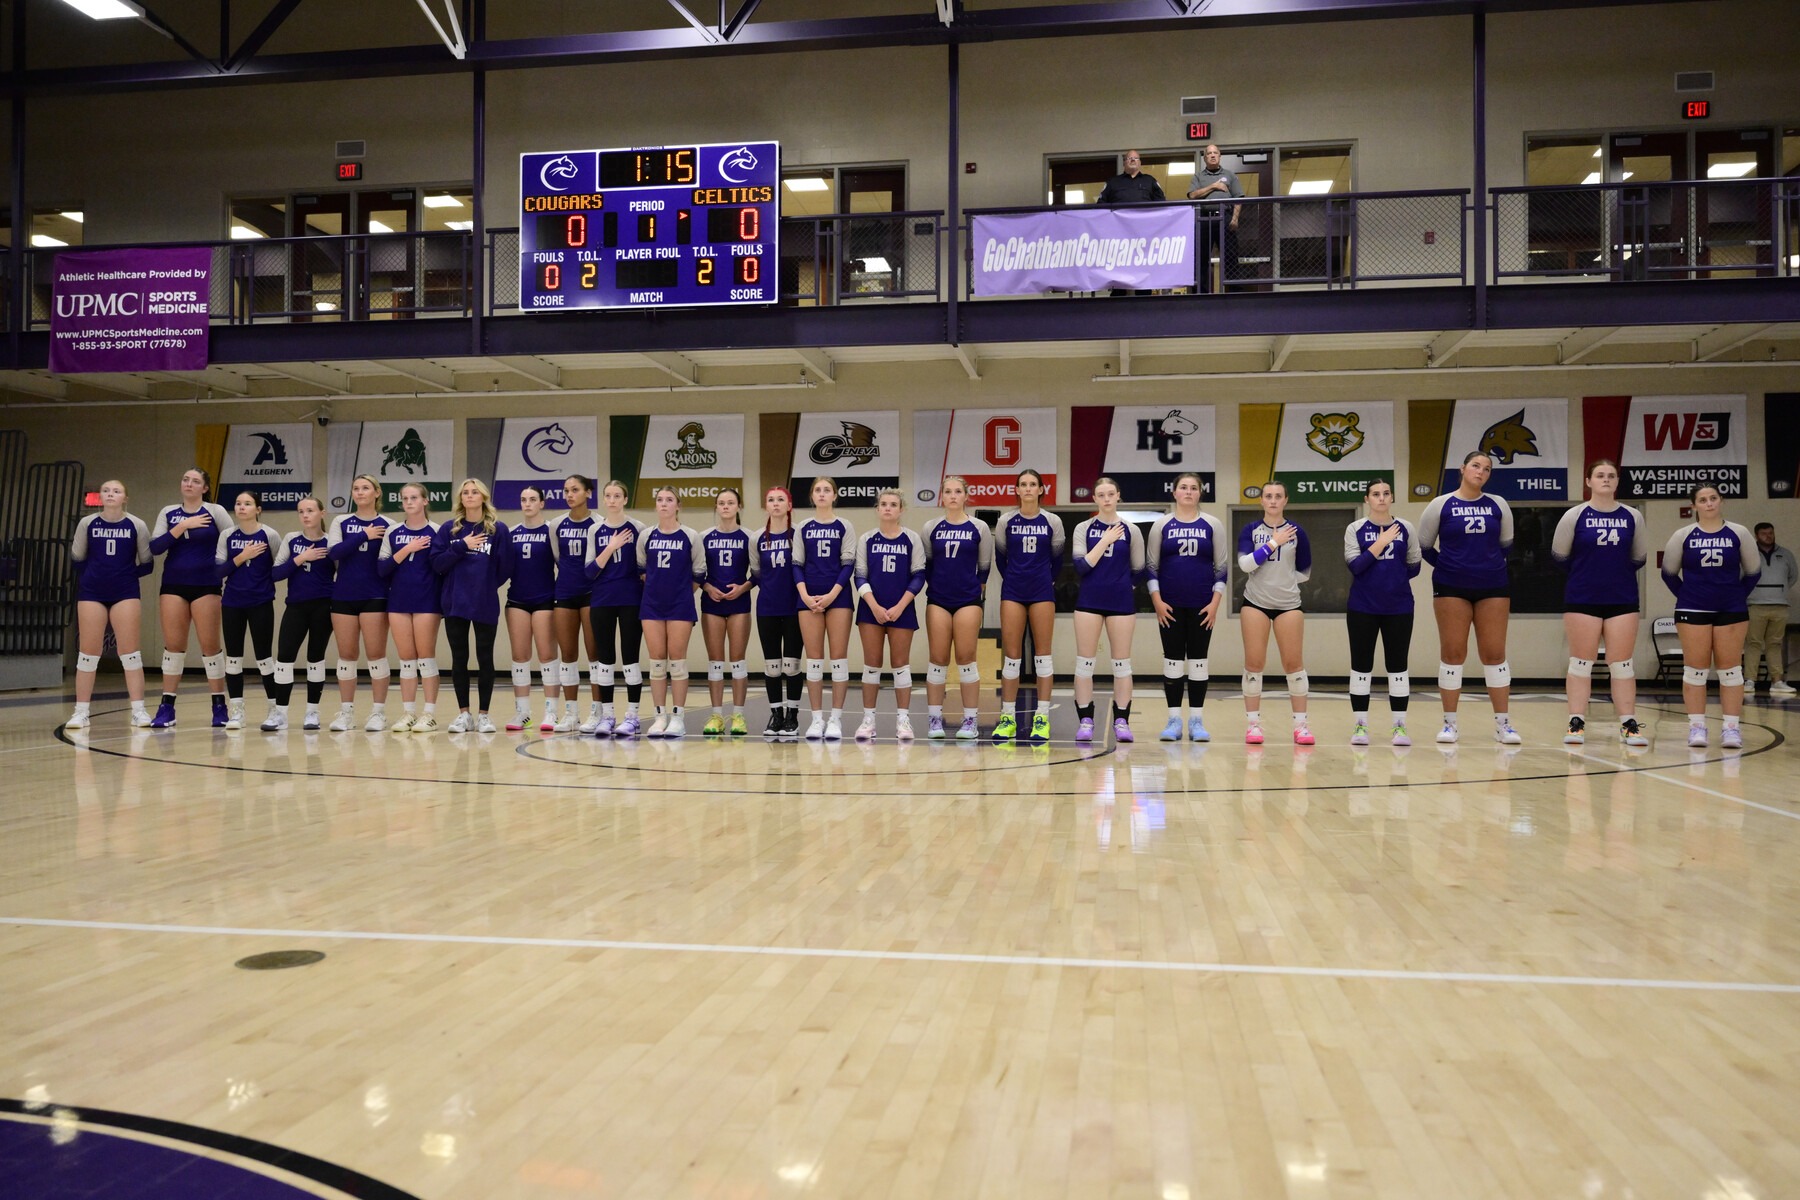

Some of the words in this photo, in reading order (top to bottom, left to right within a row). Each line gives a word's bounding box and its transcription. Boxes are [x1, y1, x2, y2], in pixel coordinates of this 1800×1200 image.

[1687, 102, 1707, 116] EXIT
[1190, 123, 1208, 138] EXIT
[339, 164, 357, 178] EXIT
[636, 151, 693, 182] 1:15
[694, 186, 772, 204] CELTICS
[525, 194, 602, 212] COUGARS
[629, 200, 665, 212] PERIOD
[568, 215, 585, 246] 0
[649, 217, 654, 238] 1
[740, 208, 759, 240] 0
[577, 251, 602, 262] T.O.L.
[616, 248, 652, 260] PLAYER
[656, 247, 681, 258] FOUL
[693, 246, 718, 257] T.O.L.
[731, 244, 763, 256] FOULS
[982, 232, 1186, 272] GoChathamCougars.com
[534, 252, 564, 263] FOULS
[59, 272, 95, 282] Athletic
[97, 271, 146, 280] Healthcare
[150, 270, 192, 279] Provided
[194, 269, 206, 278] by
[582, 264, 596, 288] 2
[698, 259, 712, 284] 2
[744, 258, 758, 283] 0
[545, 265, 559, 290] 0
[149, 292, 197, 302] SPORTS
[533, 295, 564, 306] SCORE
[630, 292, 663, 303] MATCH
[730, 289, 763, 300] SCORE
[56, 292, 138, 318] UPMC
[149, 304, 207, 314] MEDICINE
[56, 328, 203, 339] www.UPMCSportsMedicine.com
[72, 340, 147, 350] 1-855-93-SPORT
[150, 340, 186, 349] (77678)
[1644, 412, 1731, 451] W&J
[983, 416, 1022, 468] G
[809, 436, 880, 464] GENEVA
[666, 450, 716, 470] BARONS
[1629, 469, 1740, 480] WASHINGTON
[967, 484, 1016, 496] GROVE
[1297, 482, 1318, 492] ST.
[1322, 481, 1370, 492] VINCE
[1517, 478, 1562, 490] THIEL
[1633, 484, 1643, 494] &
[1648, 483, 1740, 494] JEFFEON
[261, 492, 312, 502] EGHENY
[1452, 506, 1492, 516] CHATHAM
[1011, 525, 1048, 535] CHATHAM
[1464, 516, 1486, 534] 23
[1586, 518, 1627, 529] CHATHAM
[92, 528, 131, 539] CHATHAM
[513, 534, 547, 543] CHATHAM
[560, 528, 588, 538] CHATHA
[806, 529, 840, 539] CHATHAM
[936, 530, 973, 540] CHATHAM
[1168, 528, 1206, 539] CHATHAM
[1597, 529, 1620, 546] 24
[106, 539, 116, 556] 0
[568, 540, 582, 556] 10
[649, 540, 683, 550] CHATHAM
[708, 539, 744, 550] CHATHAM
[760, 539, 790, 551] CHATHA
[817, 540, 831, 557] 15
[872, 544, 908, 555] CHATHAM
[945, 541, 961, 558] 17
[1022, 536, 1037, 553] 18
[1177, 538, 1198, 556] 20
[1690, 538, 1733, 548] CHATHAM
[522, 544, 531, 559] 9
[1700, 549, 1723, 567] 25
[657, 551, 671, 569] 12
[718, 550, 732, 567] 13
[770, 552, 786, 568] 14
[882, 555, 896, 573] 16
